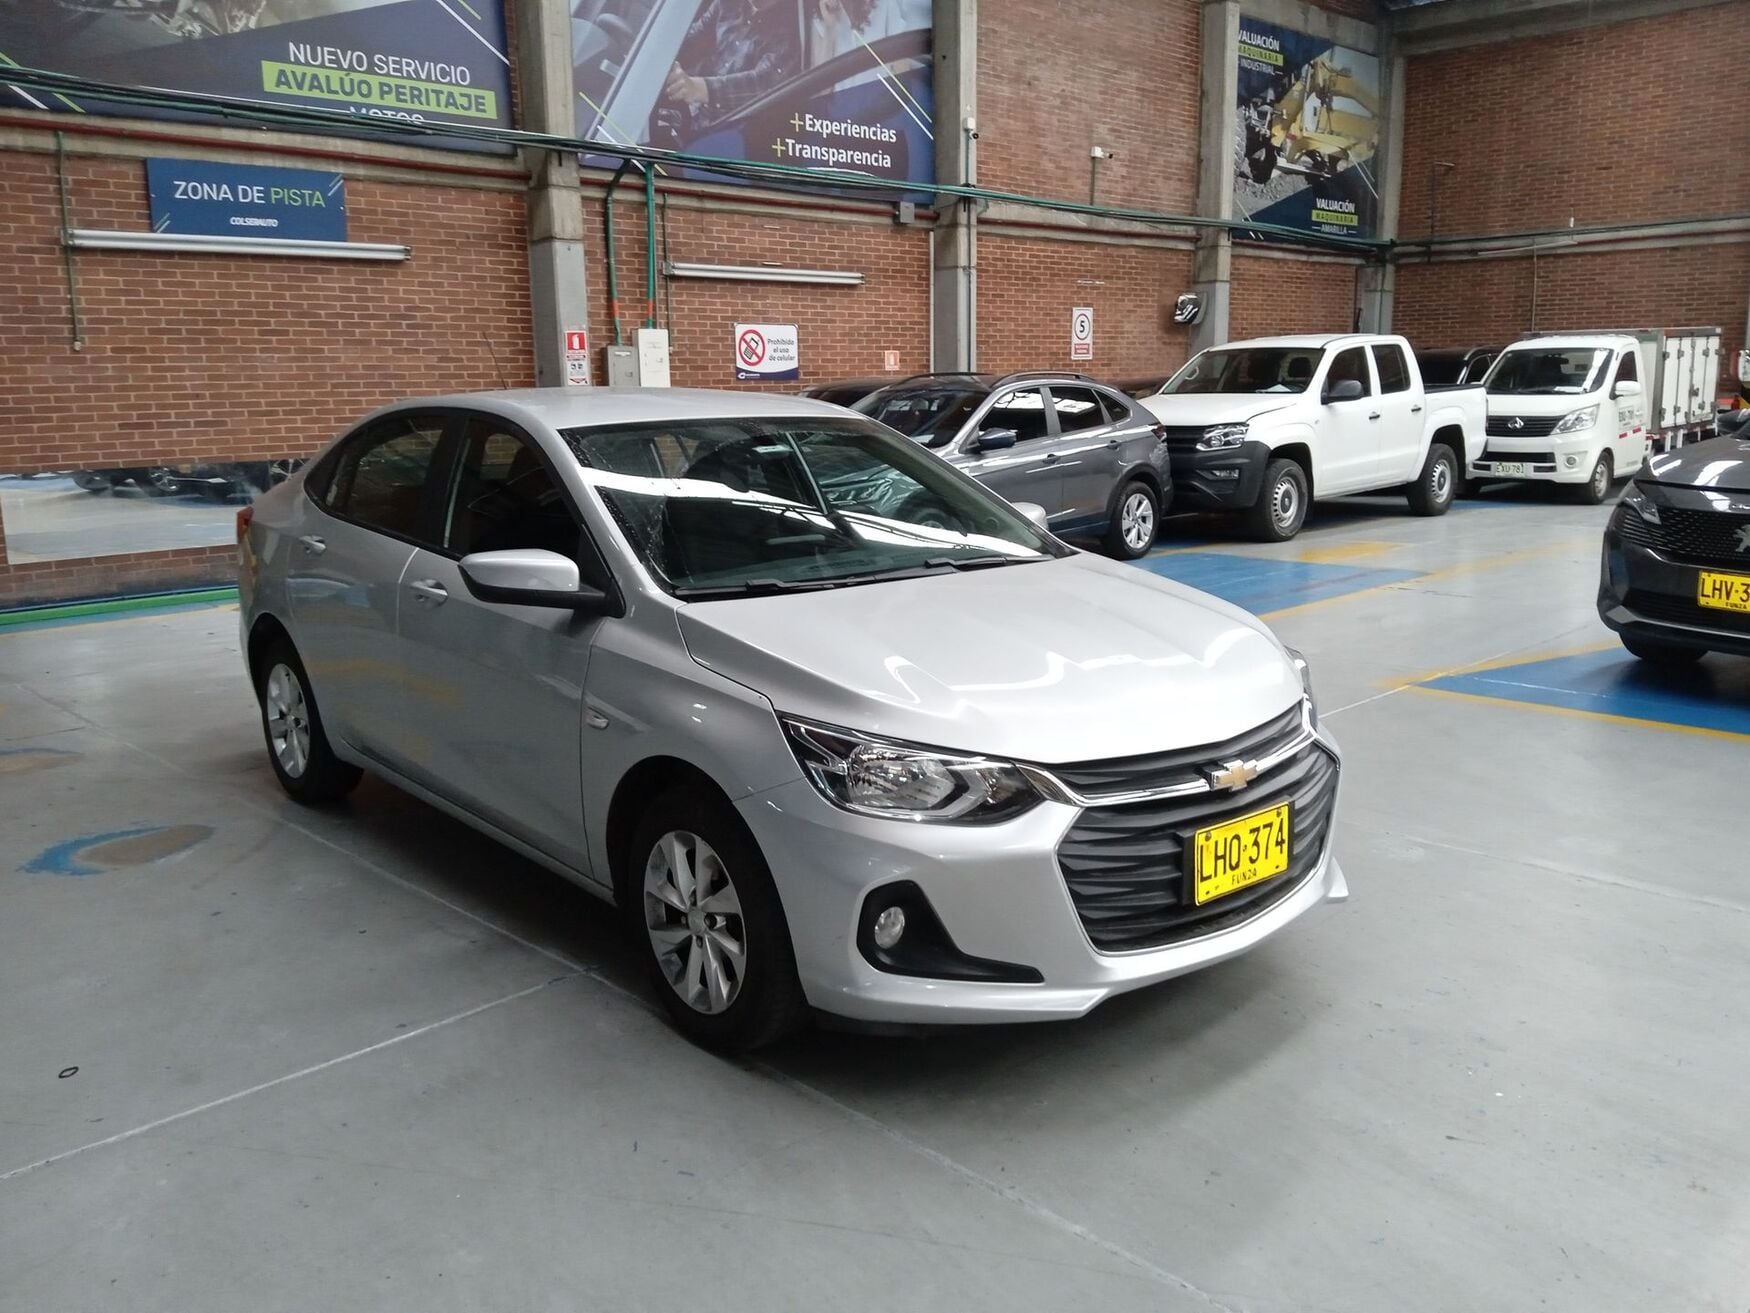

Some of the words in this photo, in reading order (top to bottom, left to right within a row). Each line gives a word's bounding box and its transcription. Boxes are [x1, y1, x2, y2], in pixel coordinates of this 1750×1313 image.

[288, 41, 368, 72] NUEVO
[374, 54, 471, 86] SERVICIO
[275, 68, 373, 98] AVALÚO
[378, 81, 487, 113] PERITAJE
[173, 180, 234, 202] ZONA
[237, 185, 266, 204] DE
[270, 187, 326, 208] PISTA
[1316, 197, 1356, 213] VALUACIÓN
[1079, 320, 1086, 333] 5
